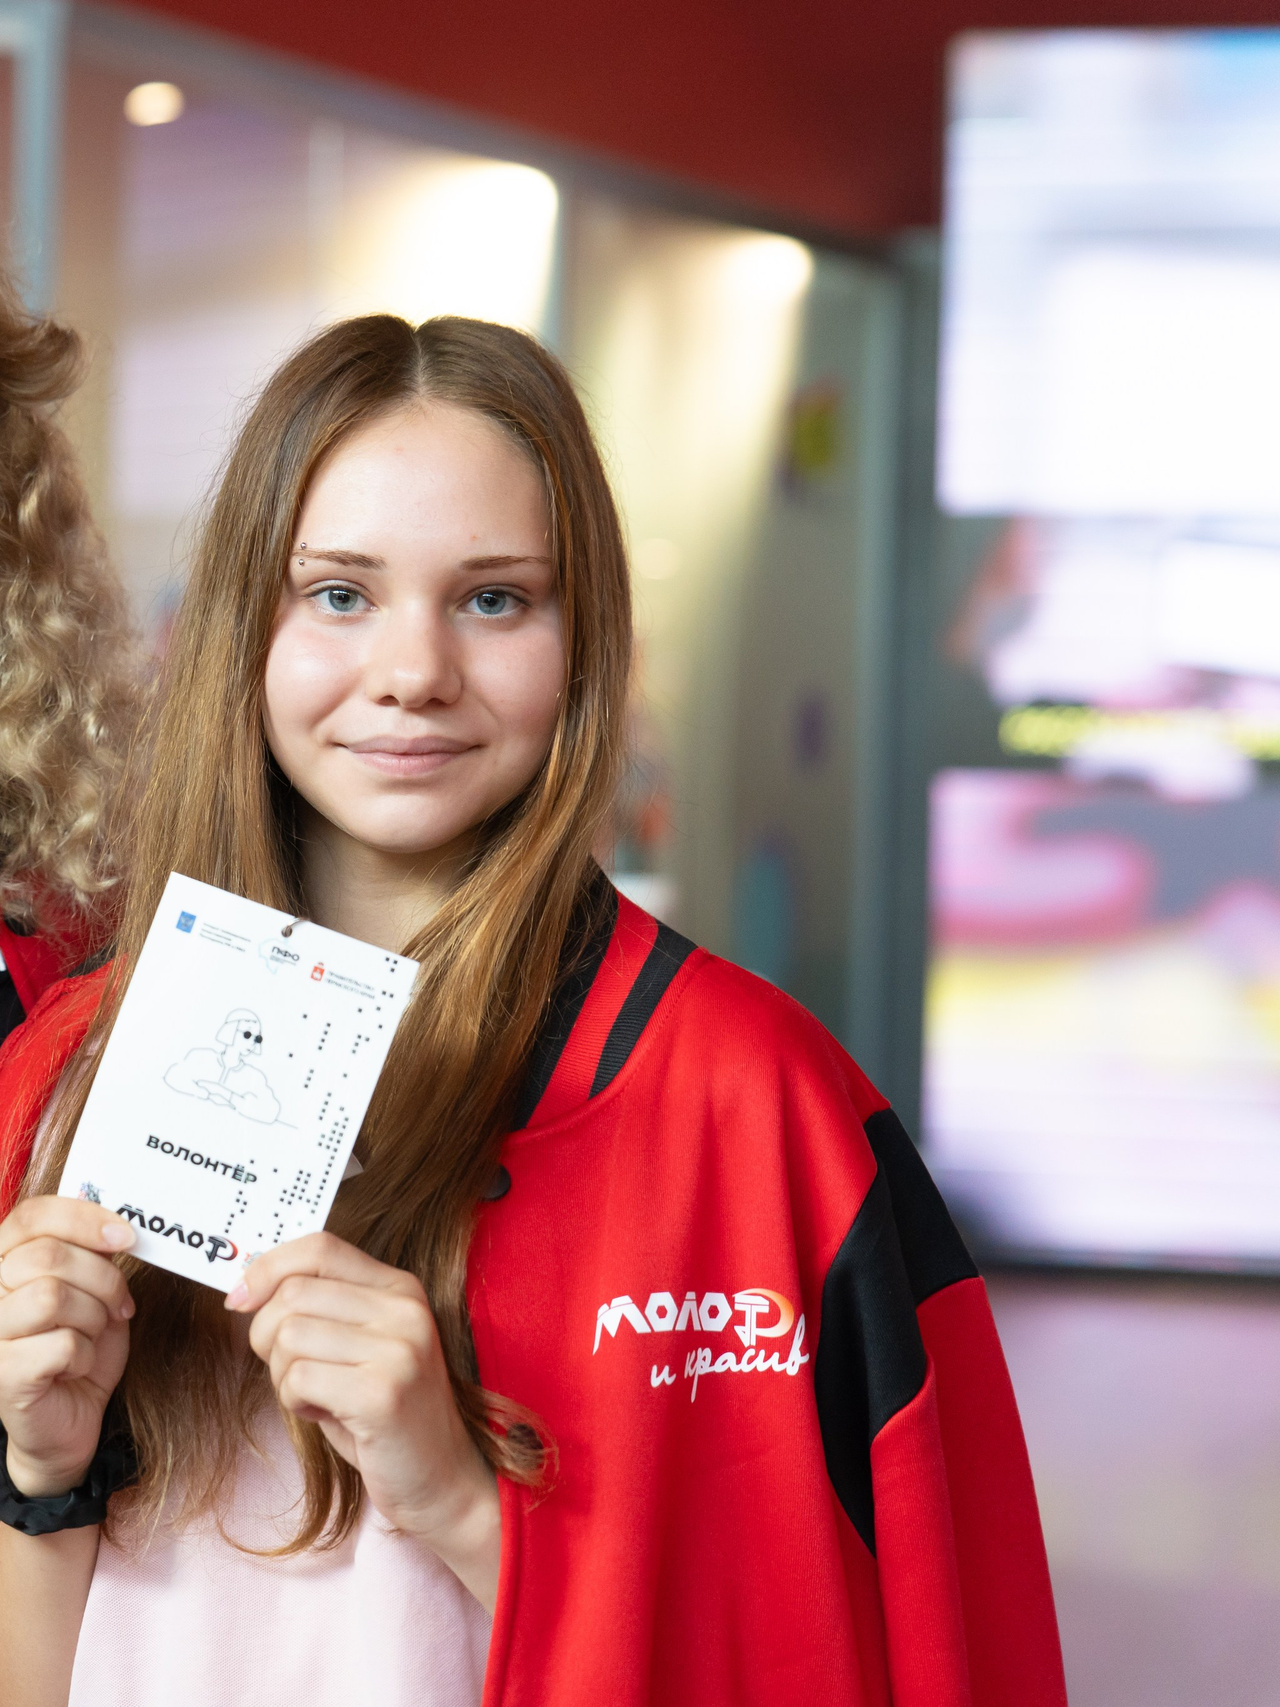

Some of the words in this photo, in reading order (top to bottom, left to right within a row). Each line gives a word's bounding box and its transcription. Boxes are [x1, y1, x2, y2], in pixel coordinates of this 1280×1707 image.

[146, 1134, 258, 1185] ВОЛОНТЁР
[650, 1364, 676, 1388] и
[684, 1313, 810, 1404] красив
